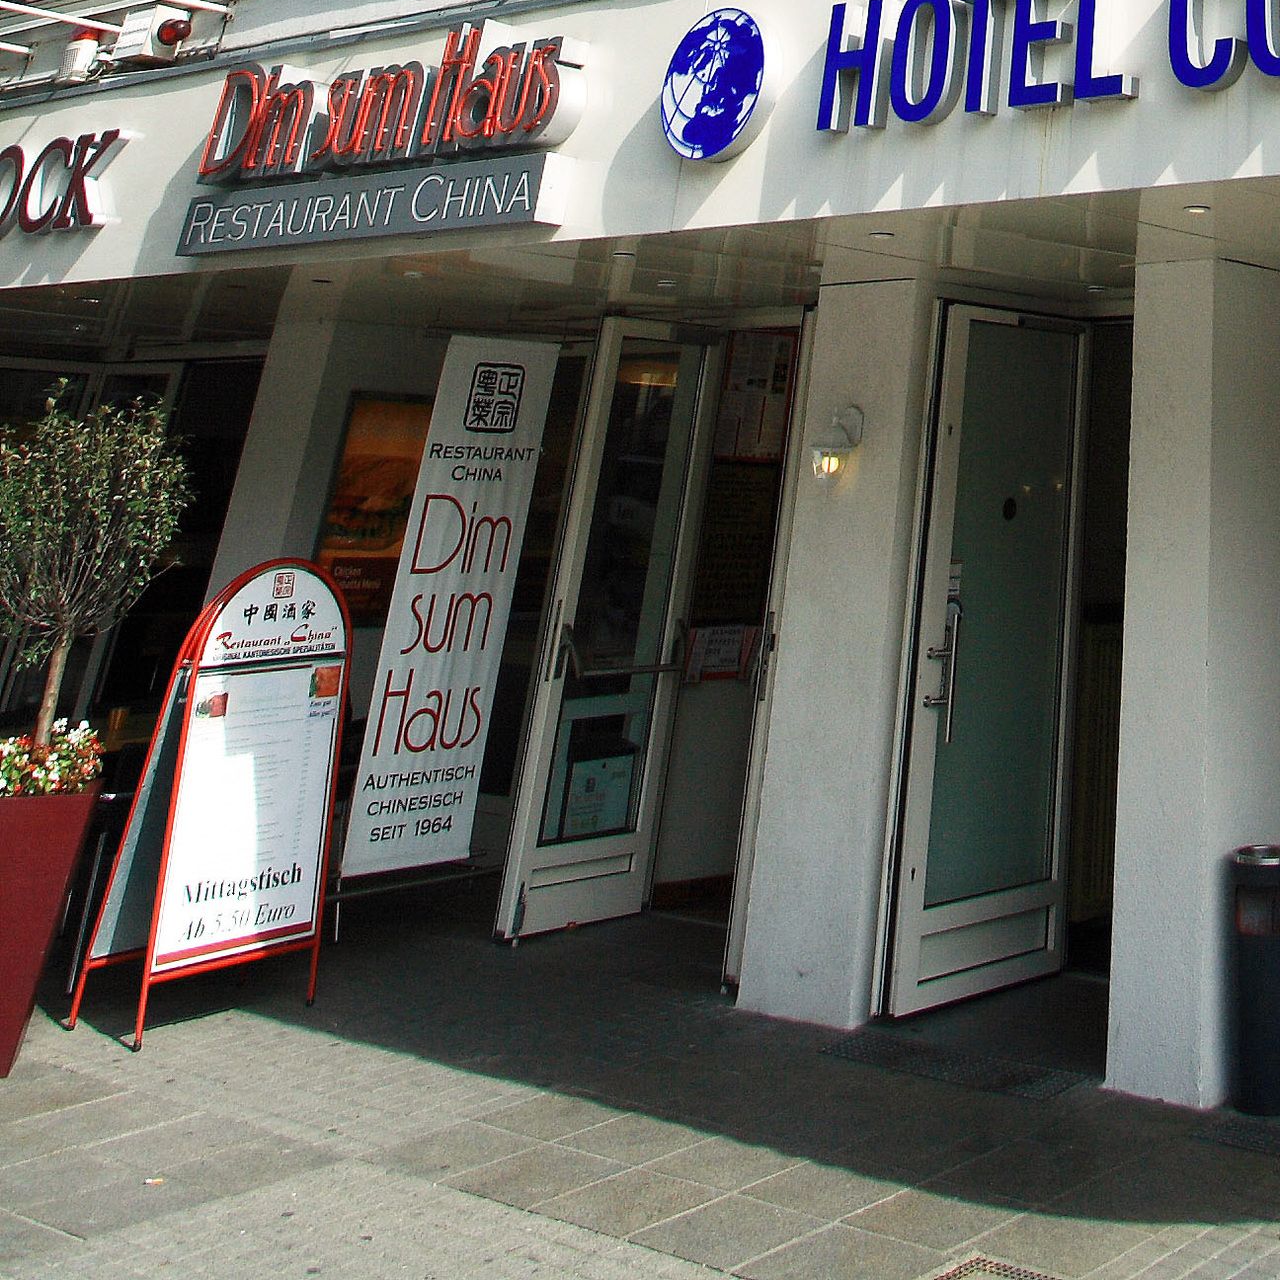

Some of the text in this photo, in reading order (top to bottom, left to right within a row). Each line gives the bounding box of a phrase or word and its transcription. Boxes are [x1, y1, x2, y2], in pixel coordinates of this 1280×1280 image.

[421, 22, 565, 147] Haus
[184, 169, 533, 247] RESTAURANT CHINA
[429, 442, 537, 462] RESTAURANT
[451, 465, 502, 482] CHINA
[410, 494, 514, 575] Dim
[400, 591, 493, 655] sum
[371, 668, 482, 758] Haus
[363, 765, 477, 792] AUTHENTISCH
[367, 791, 465, 817] CHINESISCH
[369, 815, 454, 843] SEIT 1964
[181, 861, 304, 906] Mittagstisch
[253, 903, 296, 927] Euro
